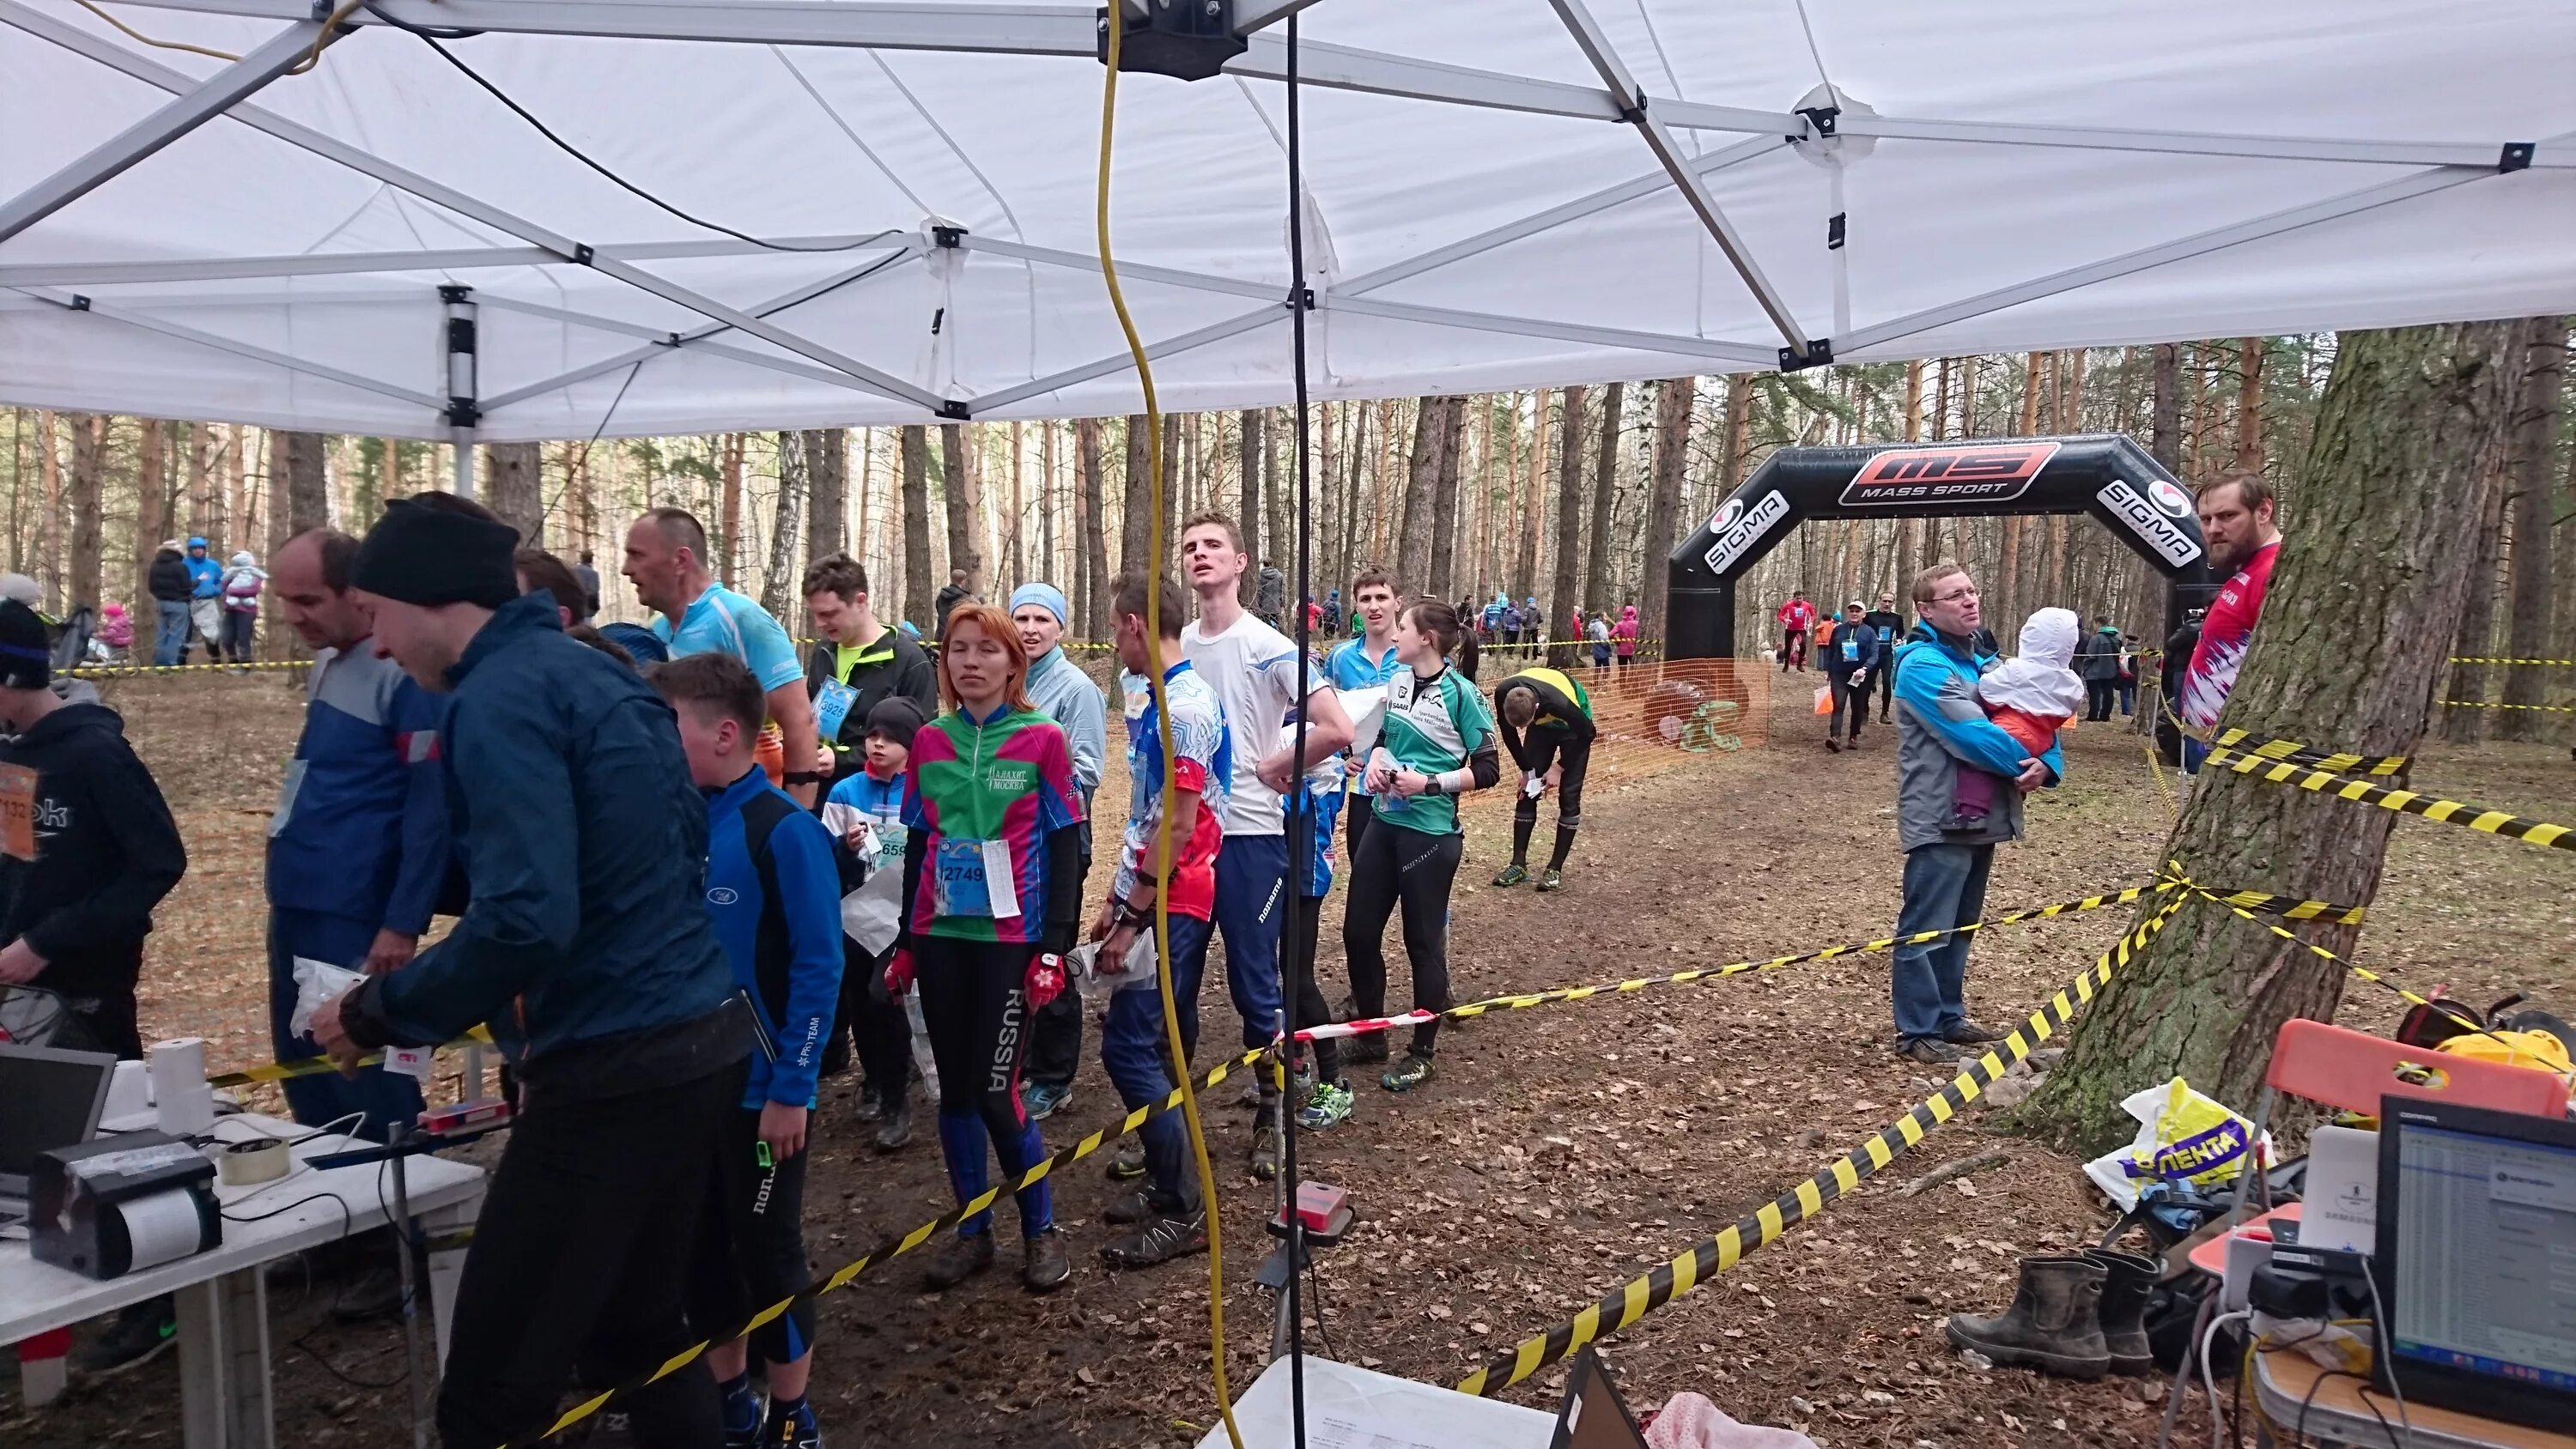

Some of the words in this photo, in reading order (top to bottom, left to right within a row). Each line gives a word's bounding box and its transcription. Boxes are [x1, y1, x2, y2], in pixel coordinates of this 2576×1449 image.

[1860, 486, 1927, 498] MASS
[1932, 482, 2008, 495] SPORT
[2104, 483, 2192, 558] SIGMA
[1708, 497, 1780, 567] SIGMA
[821, 700, 845, 718] 3925
[1392, 702, 1409, 711] SAAB
[993, 780, 1024, 791] МОСКВА
[0, 798, 26, 819] 132
[945, 867, 983, 882] 2749
[1258, 876, 1284, 924] noname
[807, 1017, 820, 1040] TEAM
[987, 989, 1024, 1092] RUSSIA
[2159, 1131, 2240, 1175] ЛЕНТА
